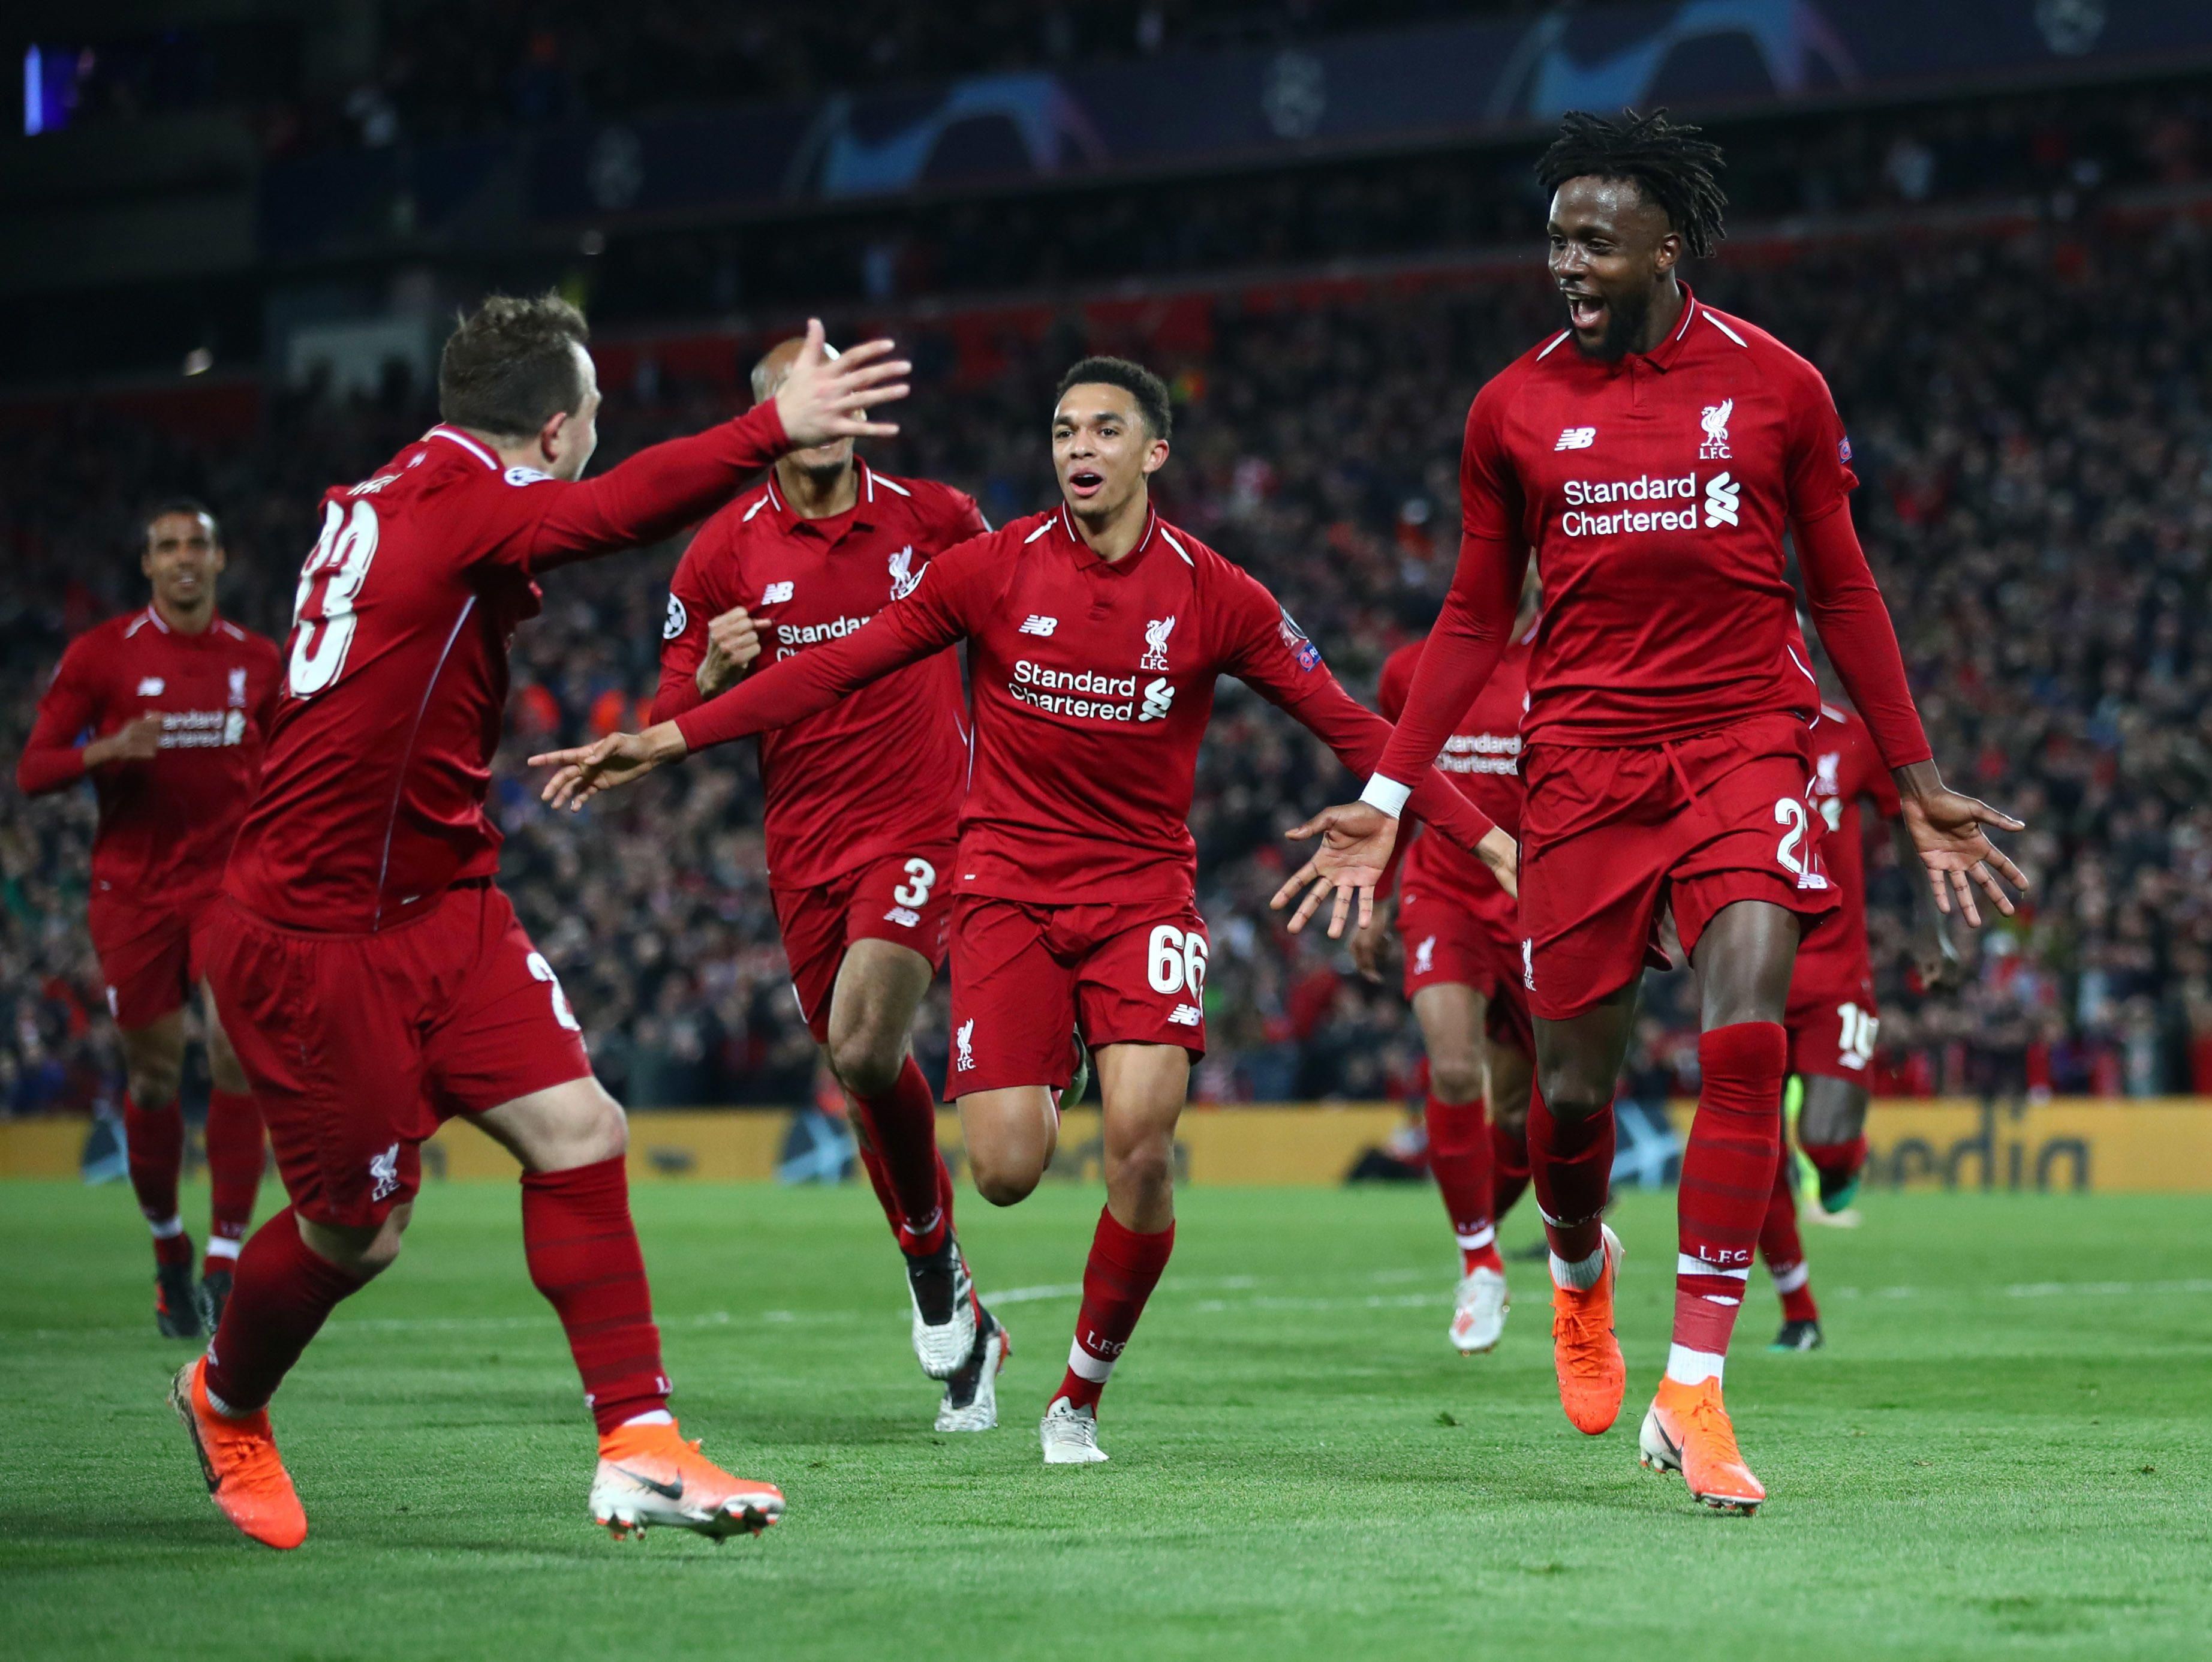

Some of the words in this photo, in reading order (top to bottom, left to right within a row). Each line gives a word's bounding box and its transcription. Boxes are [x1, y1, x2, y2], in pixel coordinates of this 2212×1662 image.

[1563, 472, 1696, 506] Standard
[1562, 505, 1697, 537] Chartered
[777, 614, 875, 645] Standar
[1014, 660, 1136, 697] Standard
[1009, 683, 1133, 721] Chartered
[894, 858, 935, 908] 3
[1148, 924, 1209, 999] 66
[1837, 1001, 1879, 1061] 10
